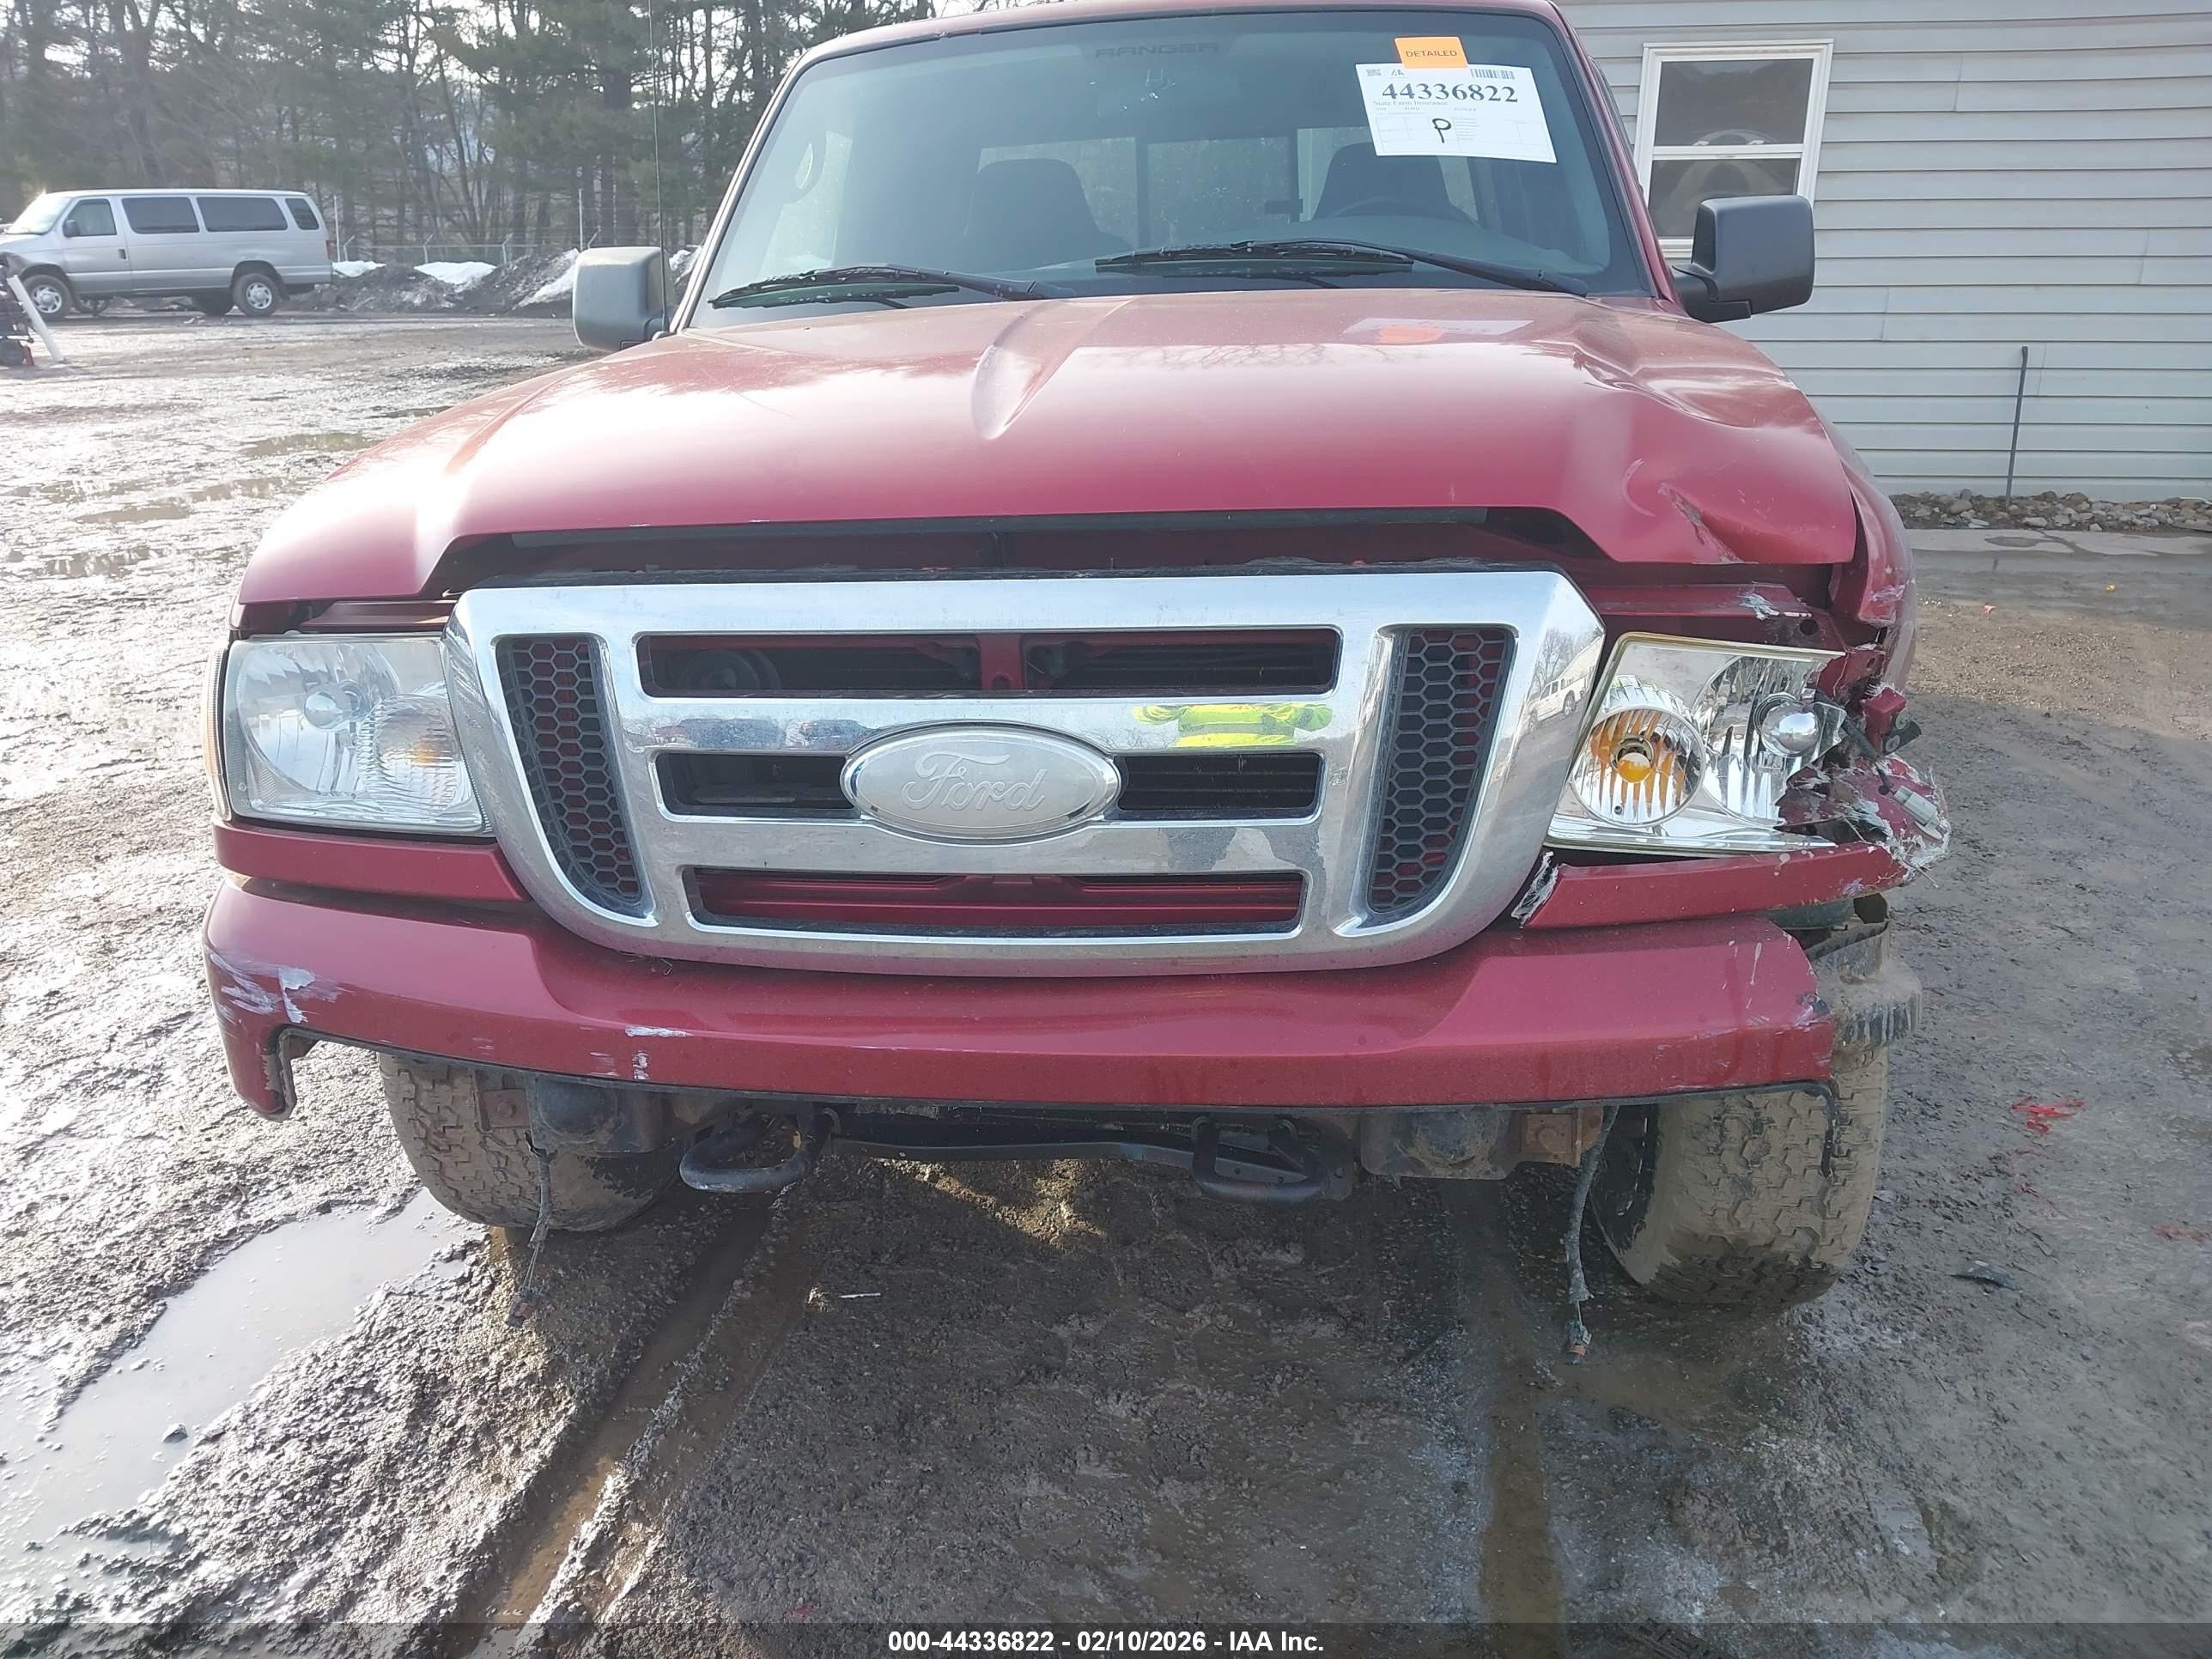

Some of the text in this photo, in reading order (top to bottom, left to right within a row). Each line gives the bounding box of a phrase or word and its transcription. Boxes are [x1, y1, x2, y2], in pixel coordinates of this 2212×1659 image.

[1095, 42, 1219, 58] RANGER
[1405, 49, 1458, 58] DETAILED
[1382, 82, 1518, 103] 44336822
[1431, 118, 1452, 143] P
[902, 752, 1048, 811] Ford
